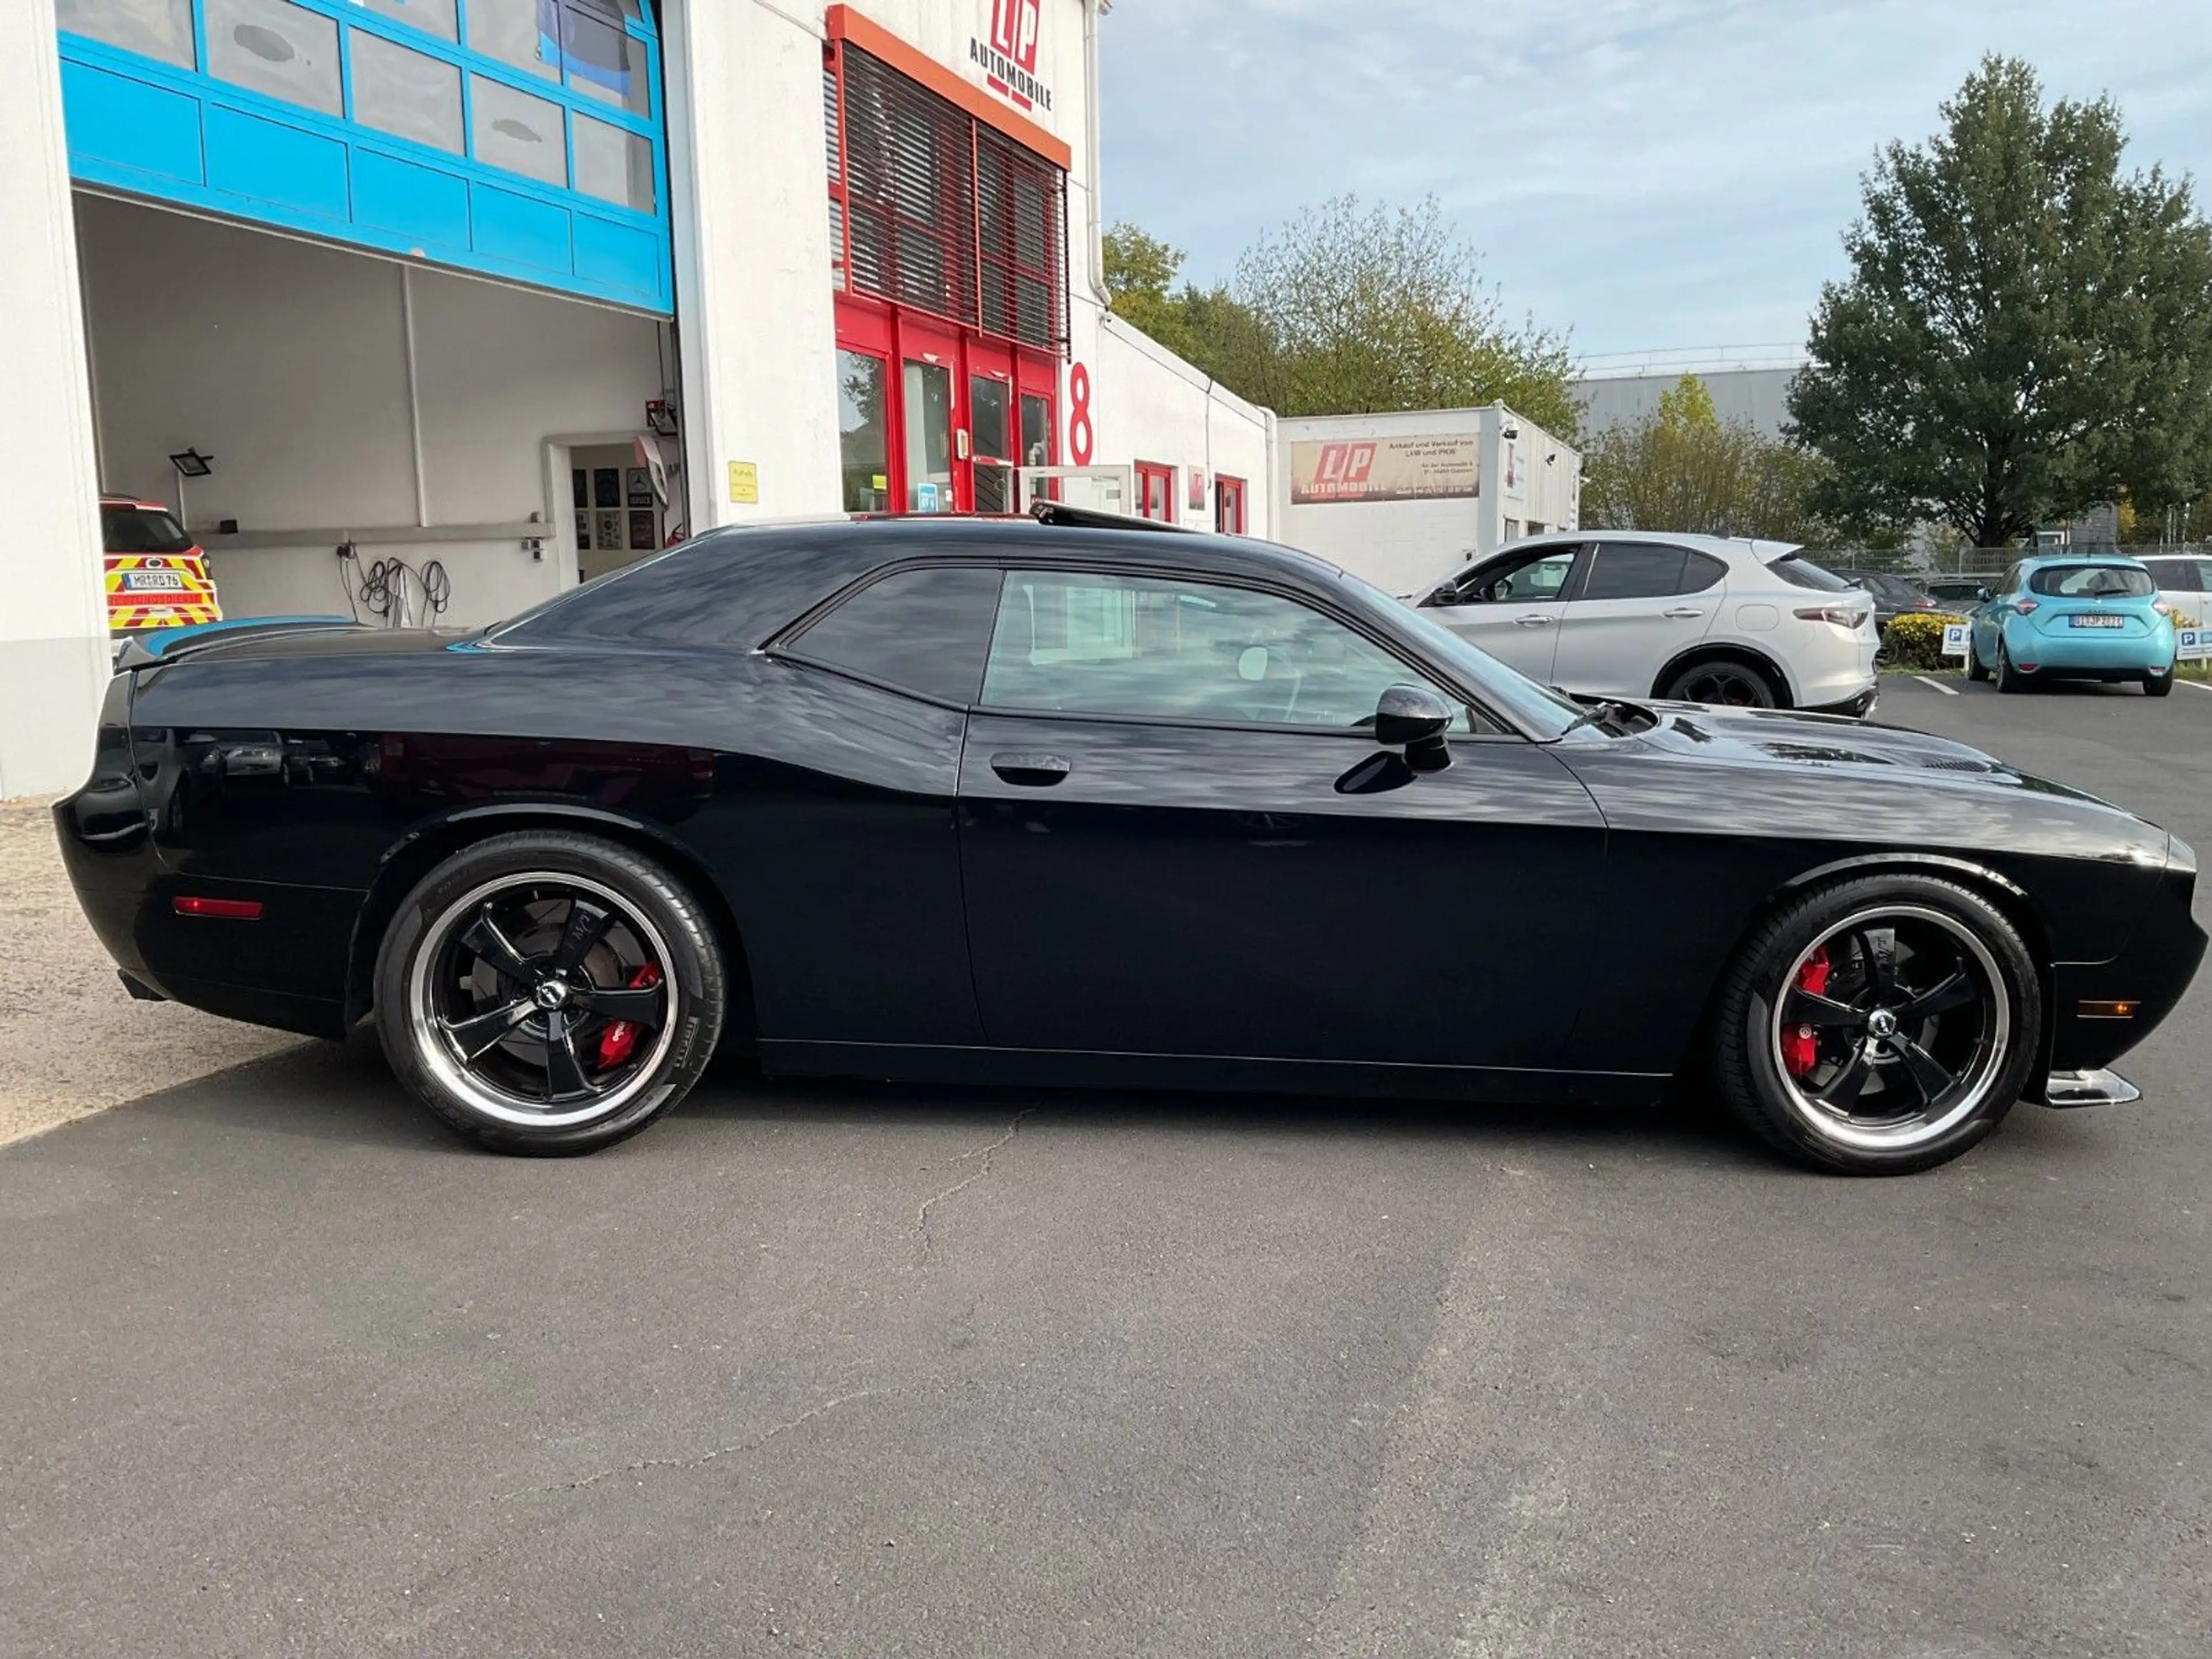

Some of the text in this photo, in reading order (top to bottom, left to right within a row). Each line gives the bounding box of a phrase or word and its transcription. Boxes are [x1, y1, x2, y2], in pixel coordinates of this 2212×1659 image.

[970, 37, 1052, 112] AUTOMOBILE
[1070, 362, 1092, 467] 8
[1322, 449, 1371, 479] LP
[1951, 631, 1960, 640] P
[2184, 635, 2193, 644] P
